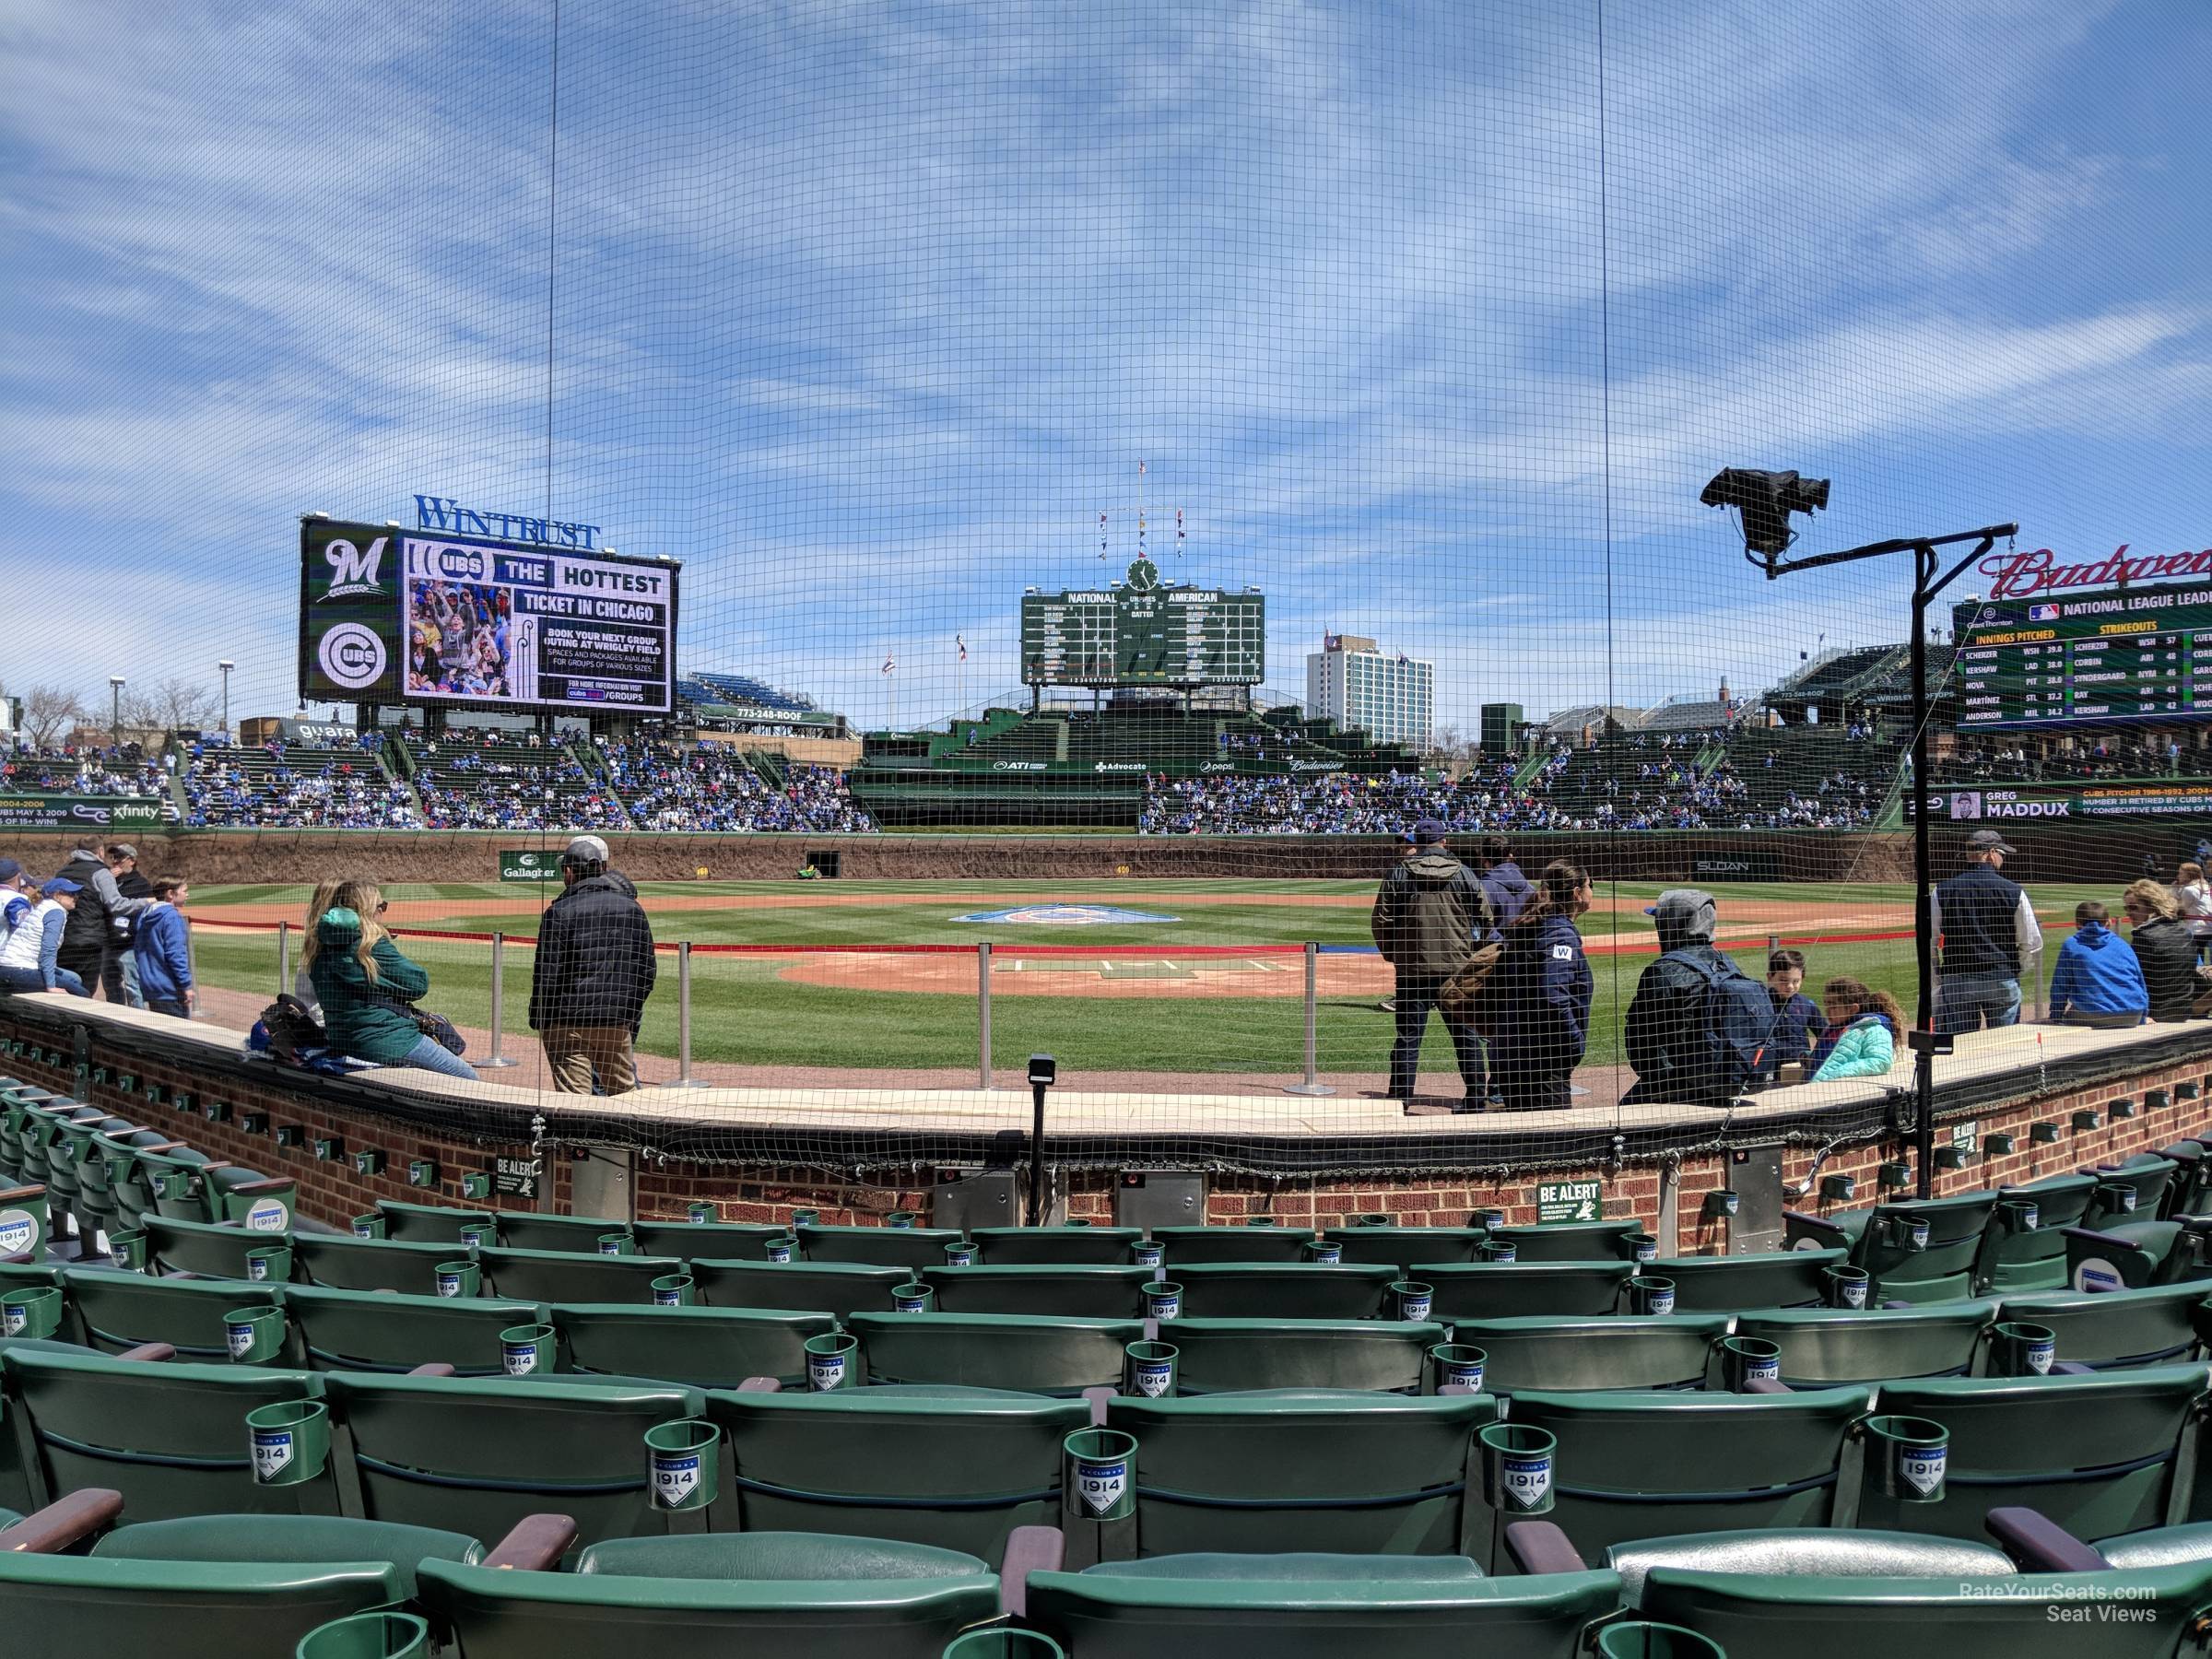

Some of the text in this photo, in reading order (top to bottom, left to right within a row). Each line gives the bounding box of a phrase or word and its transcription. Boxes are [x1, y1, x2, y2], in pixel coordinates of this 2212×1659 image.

[413, 495, 601, 549] WINTRUST
[505, 560, 545, 582] THE
[564, 566, 662, 594] HOTTEST
[1068, 593, 1118, 604] NATIONAL
[1168, 593, 1218, 602] AMERICAN
[524, 593, 654, 622] TICKET IN CHICAGO
[2064, 600, 2124, 616] NATIONAL
[2128, 594, 2174, 610] LEAGUE
[1986, 619, 2013, 628] Thornton
[2099, 620, 2158, 635] STRIKEOUTS
[547, 629, 657, 645] BOOK YOUR NEXT GROUP
[1976, 629, 2055, 645] INNINGS PITCHED
[544, 637, 662, 655] OUTING AT WRIGLEY FIELD
[2074, 641, 2109, 651] SCHERZER
[2138, 638, 2156, 646] WSH
[590, 653, 623, 661] PACKAGES
[624, 655, 657, 664] AVAILABLE
[1965, 651, 1997, 660] SCHERZER
[2023, 647, 2040, 655] WSH
[2074, 652, 2176, 666] CORBIN ARI 48
[568, 659, 594, 667] GROUPS
[606, 663, 633, 671] VARIOUS
[1966, 665, 1997, 675] KERSHAW
[2046, 661, 2062, 669] 38.0
[2026, 677, 2038, 686] PIT
[2074, 672, 2126, 683] SYNDERGAARD
[2138, 670, 2157, 678] NYM
[2140, 687, 2154, 695] ARI
[2167, 685, 2176, 693] 43
[1877, 693, 1913, 702] WRIGLEY
[1965, 695, 2000, 706] MARTÍNEZ
[2047, 692, 2063, 700] 37.2
[1966, 708, 2063, 721] ANDERSON MIL 34.2
[2074, 705, 2109, 714] KERSHAW
[2139, 702, 2155, 711] LAD
[737, 708, 802, 722] 773-248-ROOF
[1212, 762, 1235, 772] pepsi
[1289, 760, 1344, 771] Budweiser
[1986, 791, 2017, 801] GREG
[113, 804, 159, 819] xfinity
[1986, 802, 2069, 817] MADDUX
[503, 867, 555, 878] Gallagher
[1697, 862, 1748, 871] SLOAN
[1558, 947, 1569, 957] W
[1954, 1121, 1976, 1139] BE ALERT
[498, 1159, 509, 1172] BE
[1540, 1182, 1599, 1203] BE ALERT
[0, 1230, 27, 1241] 1914
[1154, 1306, 1175, 1314] 1914
[812, 1367, 840, 1377] 1914
[1140, 1374, 1167, 1383] 1914
[1452, 1377, 1478, 1386] 1914
[1908, 1461, 1942, 1475] 1914
[655, 1472, 693, 1485] 1914
[1083, 1478, 1121, 1492] 1914
[1509, 1474, 1547, 1487] 1914
